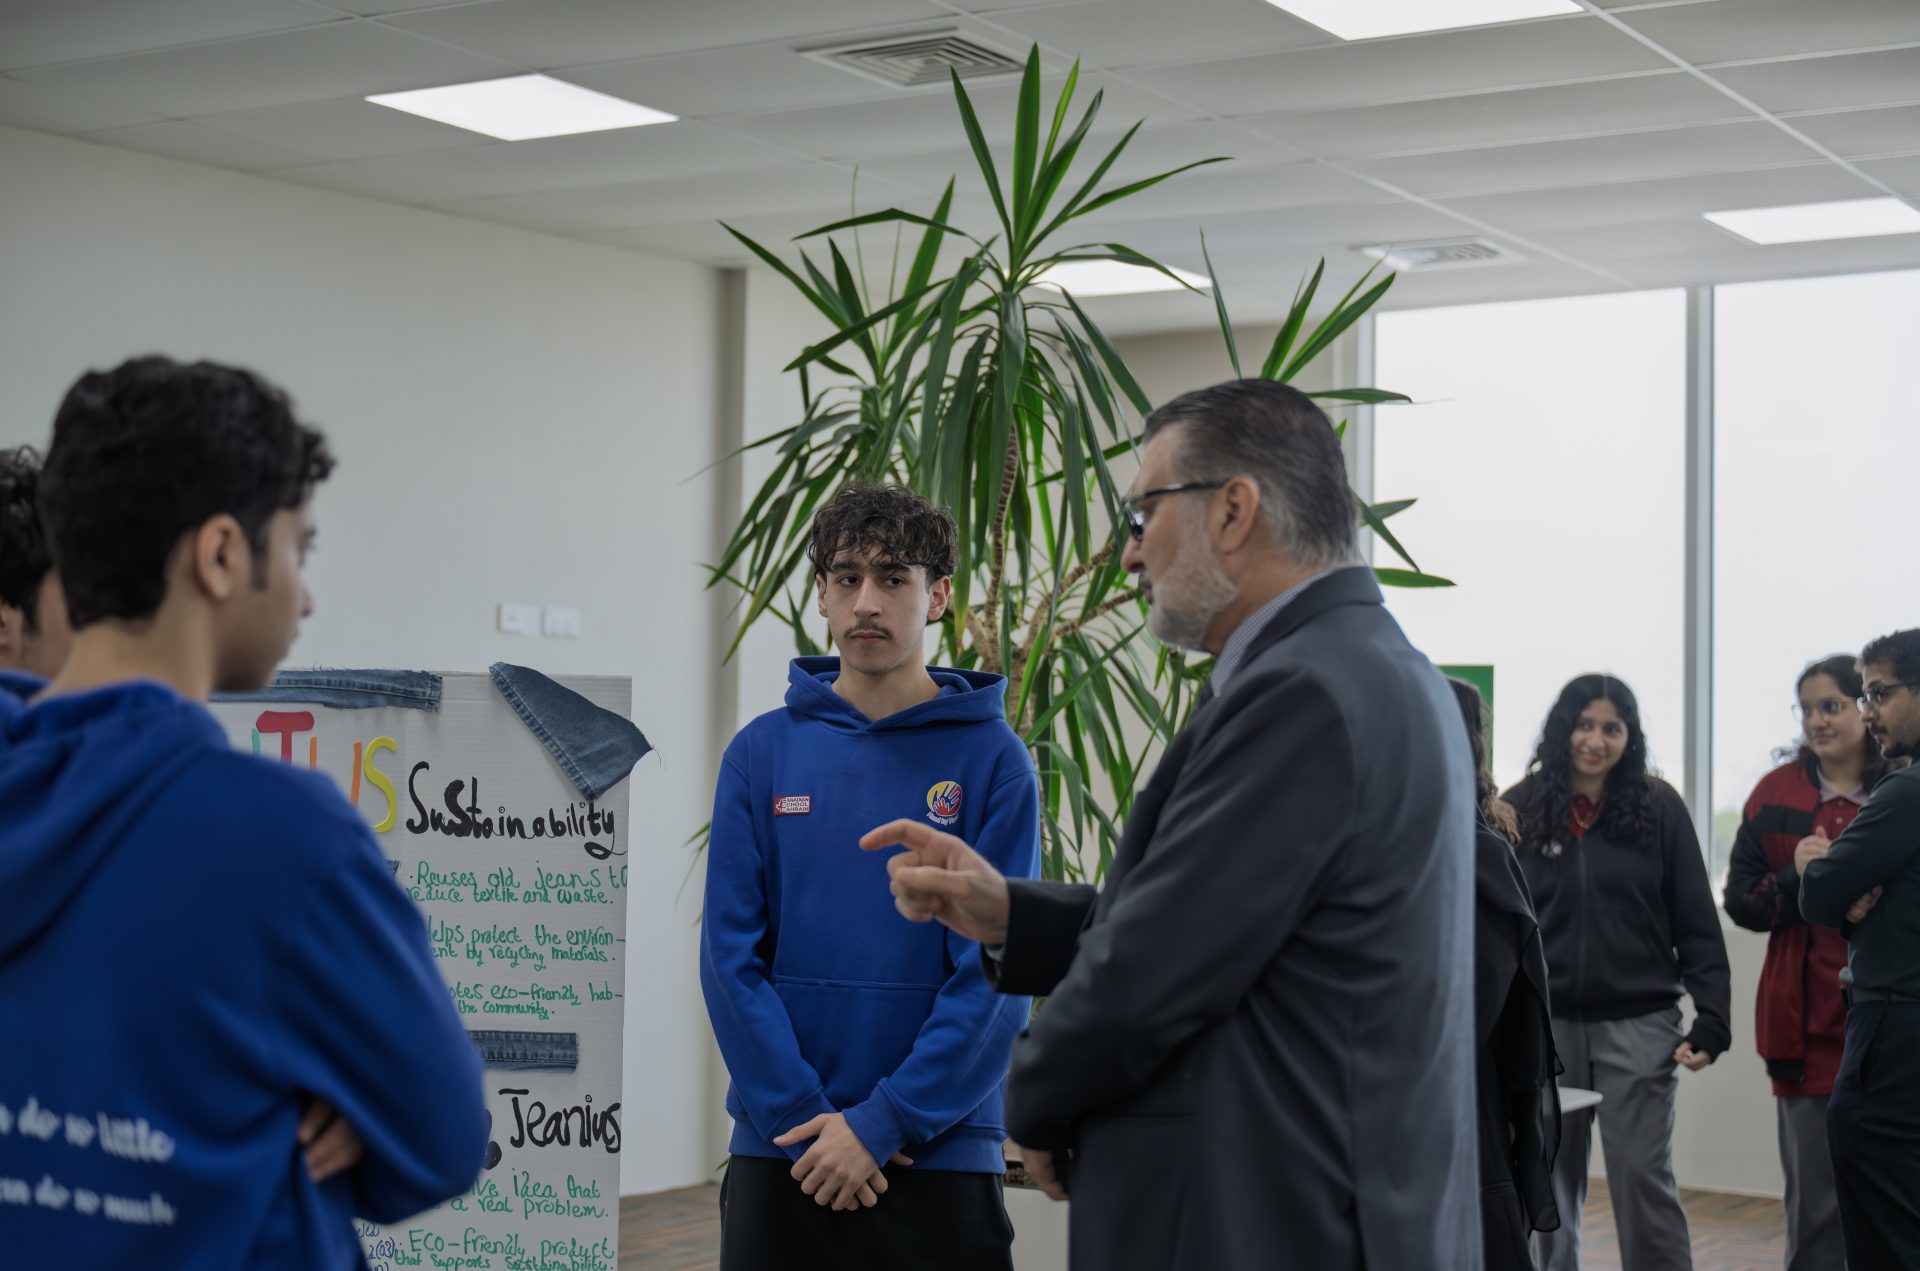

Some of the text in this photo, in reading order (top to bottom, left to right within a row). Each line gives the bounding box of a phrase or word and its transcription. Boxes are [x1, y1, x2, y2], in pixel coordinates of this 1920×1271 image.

[488, 867, 520, 888] old
[523, 889, 551, 903] and
[535, 924, 561, 945] the
[431, 943, 457, 959] ent
[466, 943, 484, 966] by
[449, 982, 483, 1000] otes
[458, 1000, 477, 1014] the
[499, 1088, 621, 1153] Jeanius
[567, 1175, 600, 1198] that
[451, 1199, 468, 1211] a
